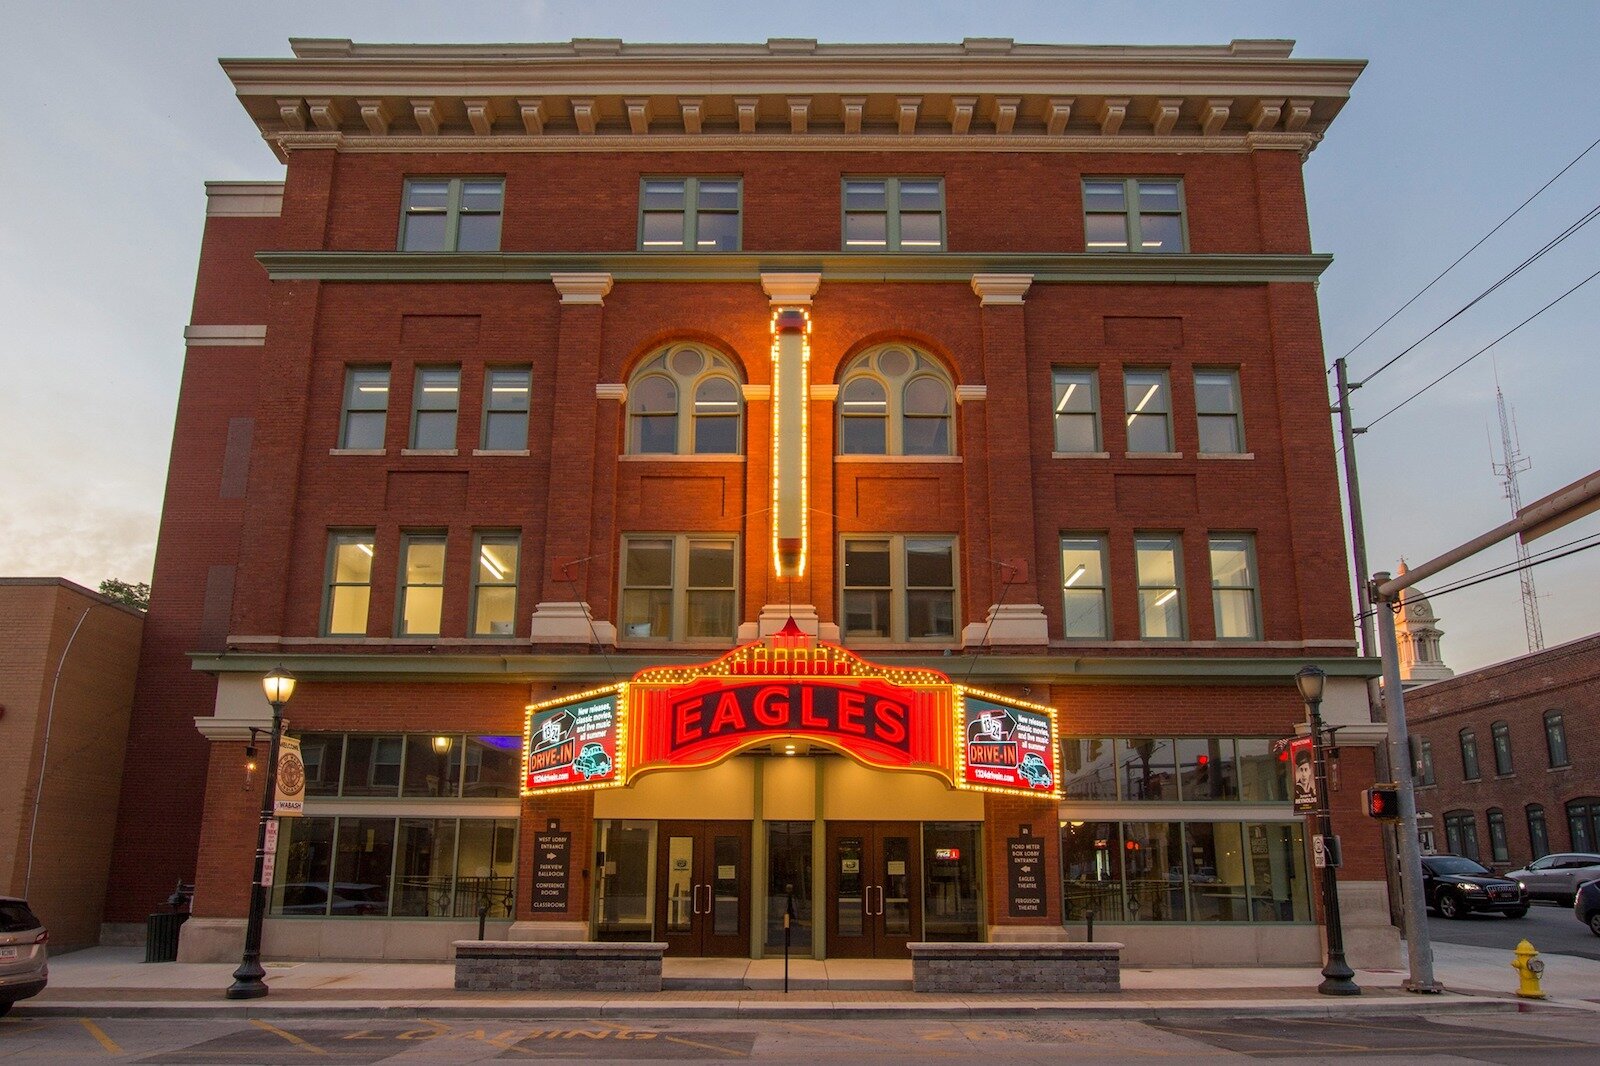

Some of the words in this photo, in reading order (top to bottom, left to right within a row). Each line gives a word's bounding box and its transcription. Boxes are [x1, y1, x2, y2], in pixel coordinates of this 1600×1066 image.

[578, 707, 588, 715] New
[589, 703, 611, 713] releases,
[675, 686, 906, 745] EAGLES
[576, 715, 592, 724] classic
[593, 712, 612, 722] movies,
[1018, 714, 1027, 723] New
[1028, 717, 1048, 729] releases,
[544, 726, 550, 738] 13
[552, 729, 558, 740] 24
[576, 725, 586, 733] and
[586, 723, 595, 731] live
[596, 721, 610, 729] music
[984, 719, 990, 730] 13
[992, 724, 999, 736] 24
[1017, 724, 1032, 732] classic
[1033, 727, 1049, 737] movies,
[587, 730, 607, 740] summer
[532, 743, 572, 770] DRIVE-IN
[970, 746, 1015, 764] DRIVE-IN
